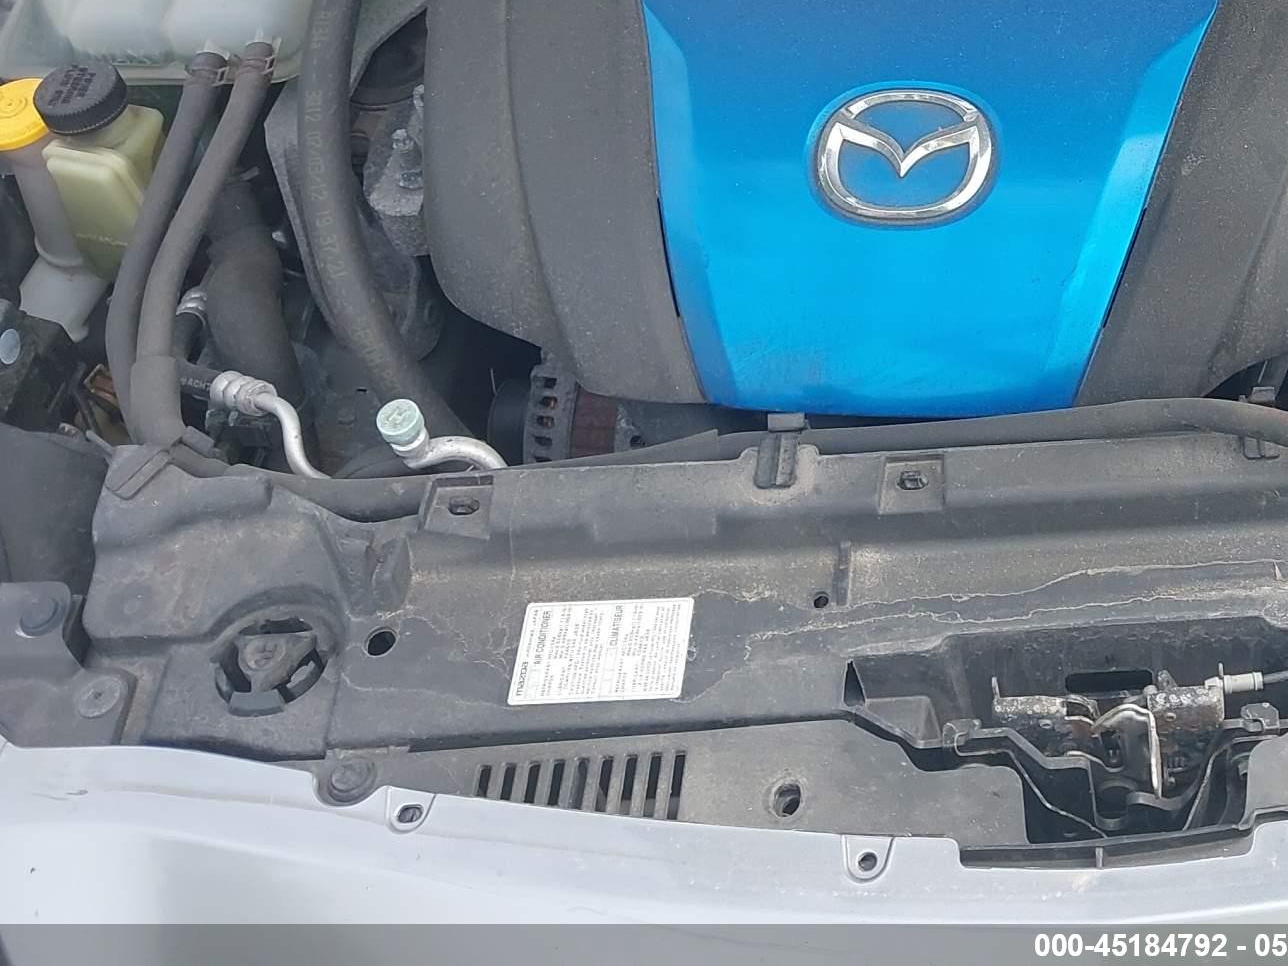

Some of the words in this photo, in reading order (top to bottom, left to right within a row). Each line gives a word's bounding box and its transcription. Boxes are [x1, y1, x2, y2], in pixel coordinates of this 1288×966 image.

[535, 609, 552, 653] CONDITIONER
[608, 604, 624, 646] CLIMATISEUR
[514, 660, 529, 696] mazda
[532, 653, 543, 665] AIR
